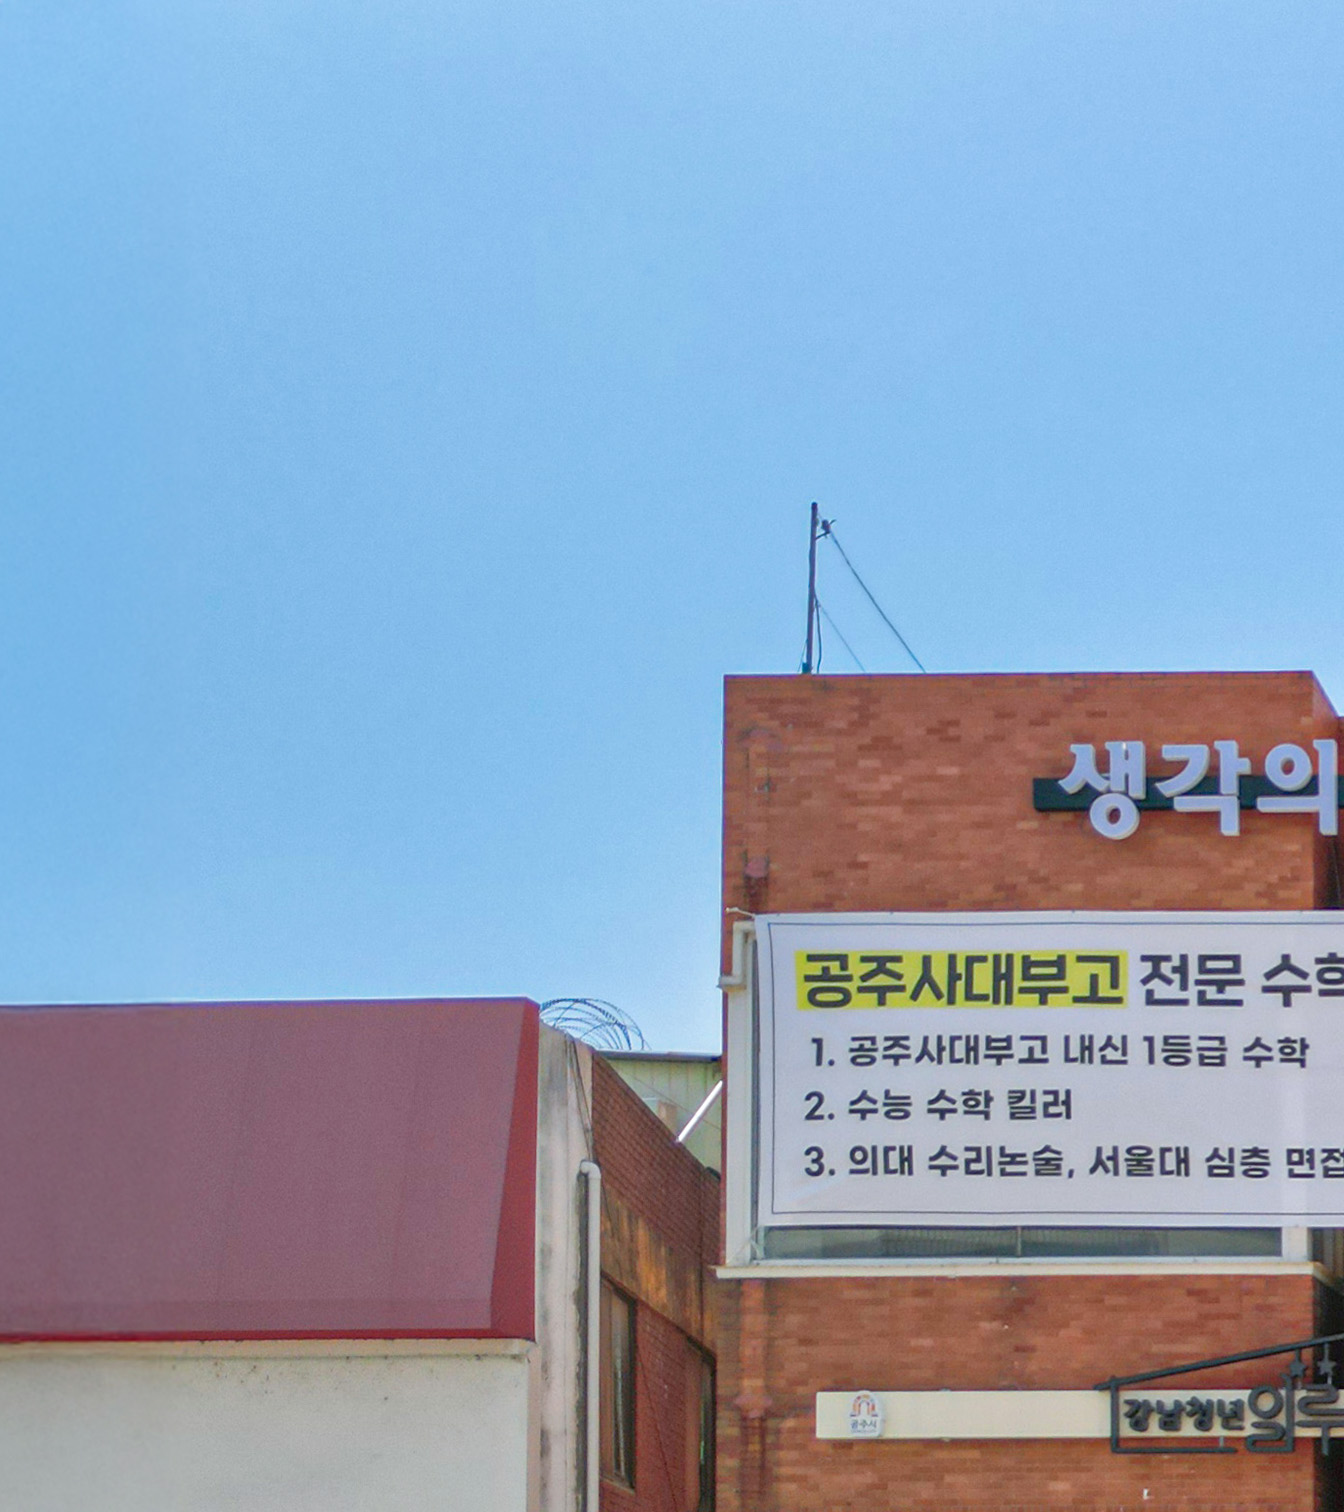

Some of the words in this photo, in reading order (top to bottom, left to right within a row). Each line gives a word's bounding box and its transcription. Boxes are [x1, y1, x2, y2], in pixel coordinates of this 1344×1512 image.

[1058, 738, 1338, 840] 생각의
[803, 951, 1125, 1008] 공주사대부고
[1139, 951, 1246, 1007] 전문
[811, 1036, 835, 1067] 1.
[848, 1034, 1050, 1067] 공주사대부고
[1063, 1033, 1129, 1066] 내신
[1143, 1034, 1228, 1067] 1등급
[1242, 1036, 1310, 1068] 수학
[804, 1091, 835, 1121] 2.
[848, 1089, 913, 1121] 수능
[926, 1088, 994, 1121] 수학
[1007, 1088, 1073, 1121] 킬러
[804, 1146, 835, 1177] 3.
[848, 1144, 914, 1178] 의대
[928, 1144, 1075, 1180] 수리논술,
[1088, 1145, 1191, 1178] 서울대
[1205, 1146, 1271, 1179] 심층
[1123, 1396, 1246, 1433] 강남청년
